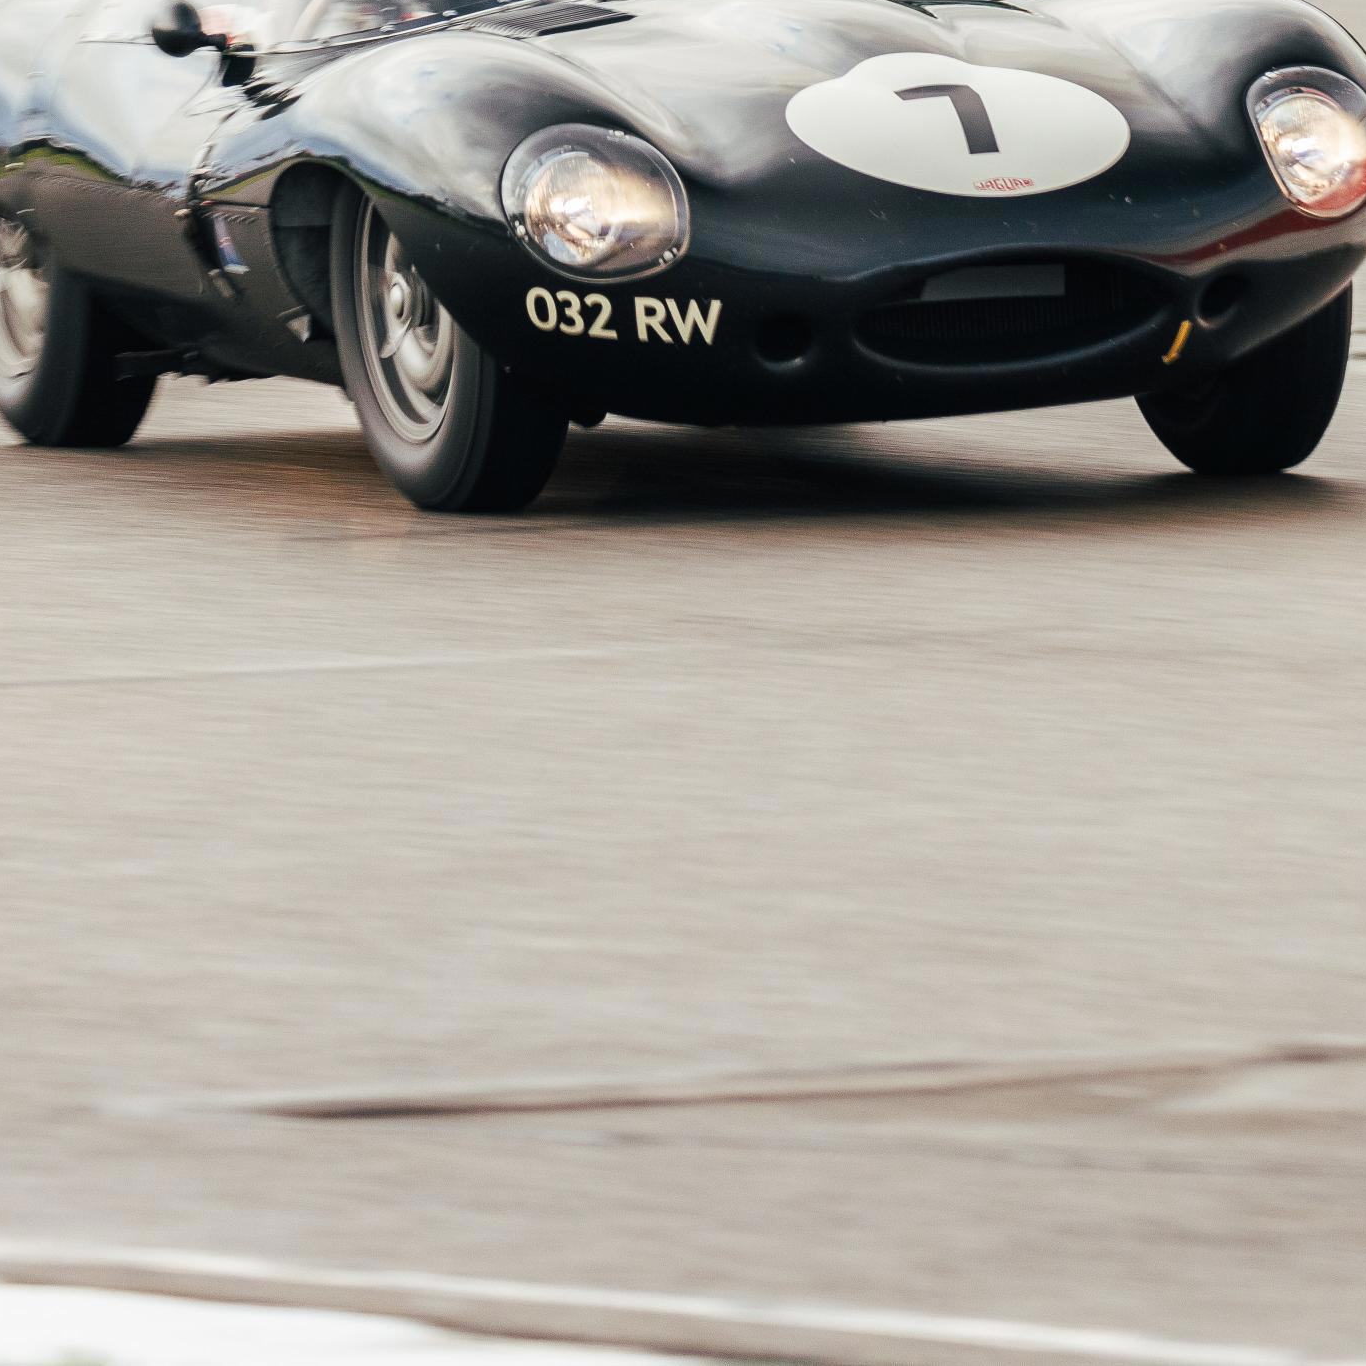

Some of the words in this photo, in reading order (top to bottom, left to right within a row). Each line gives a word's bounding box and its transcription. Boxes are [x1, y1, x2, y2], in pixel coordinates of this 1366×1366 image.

[894, 84, 1000, 154] 7
[973, 177, 1035, 191] JAGUAR
[525, 287, 618, 340] 032
[634, 296, 722, 345] RW
